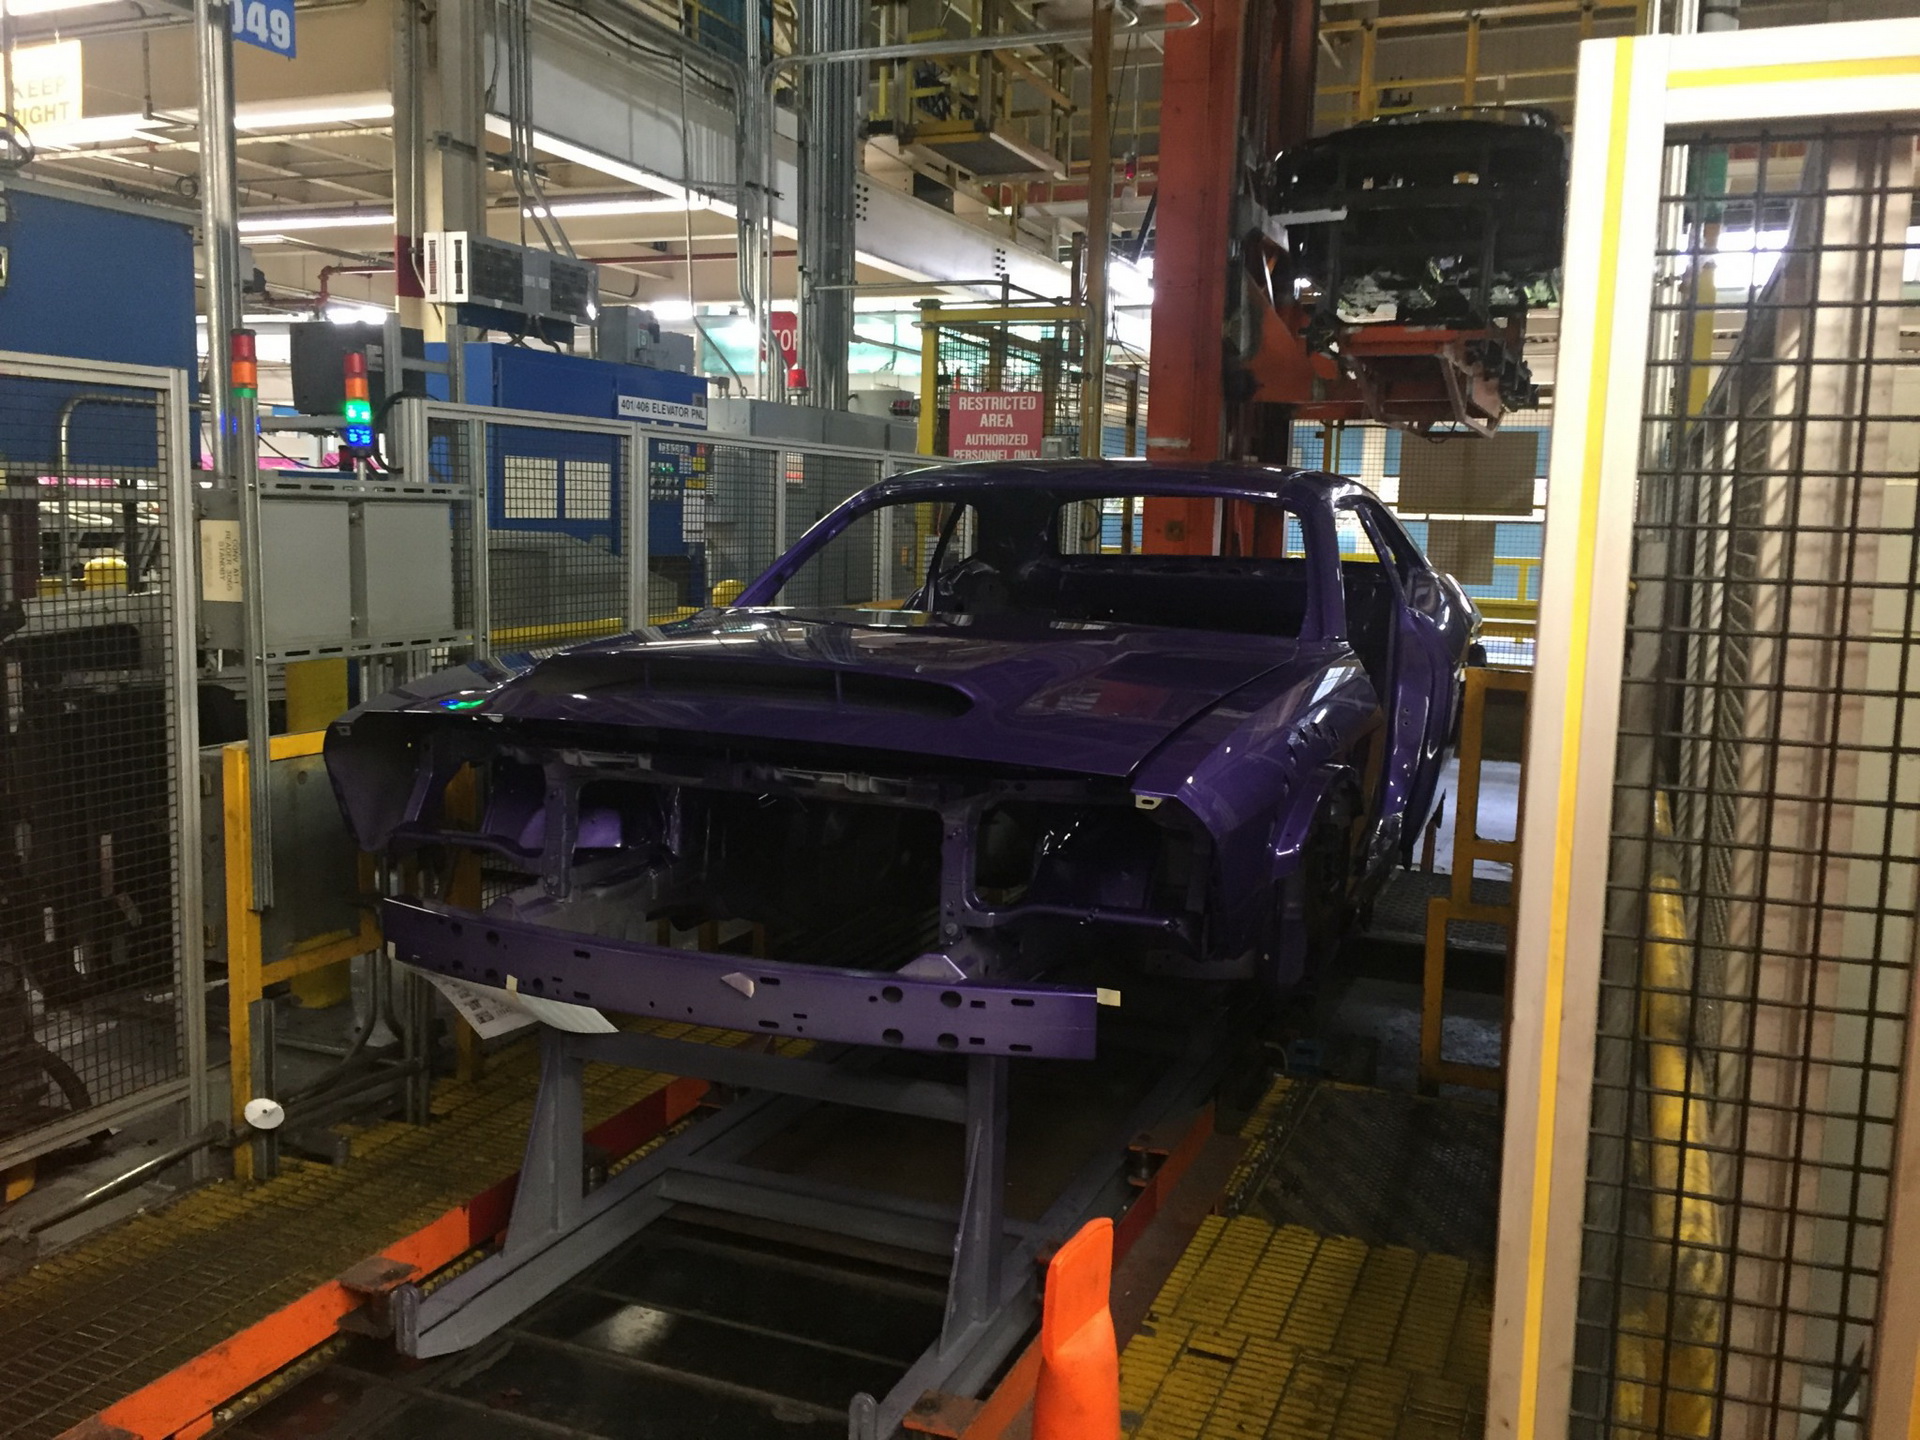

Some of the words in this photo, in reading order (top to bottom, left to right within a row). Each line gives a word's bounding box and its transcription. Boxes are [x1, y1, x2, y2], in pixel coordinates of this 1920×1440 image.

[958, 396, 1037, 411] RESTRICTED
[651, 402, 690, 418] ELEVATOR
[690, 408, 705, 421] PNL
[979, 413, 1014, 428] AREA
[964, 433, 1029, 446] AUTHORIZED
[953, 449, 1008, 460] PERSONNEL
[1014, 449, 1038, 460] ONLY
